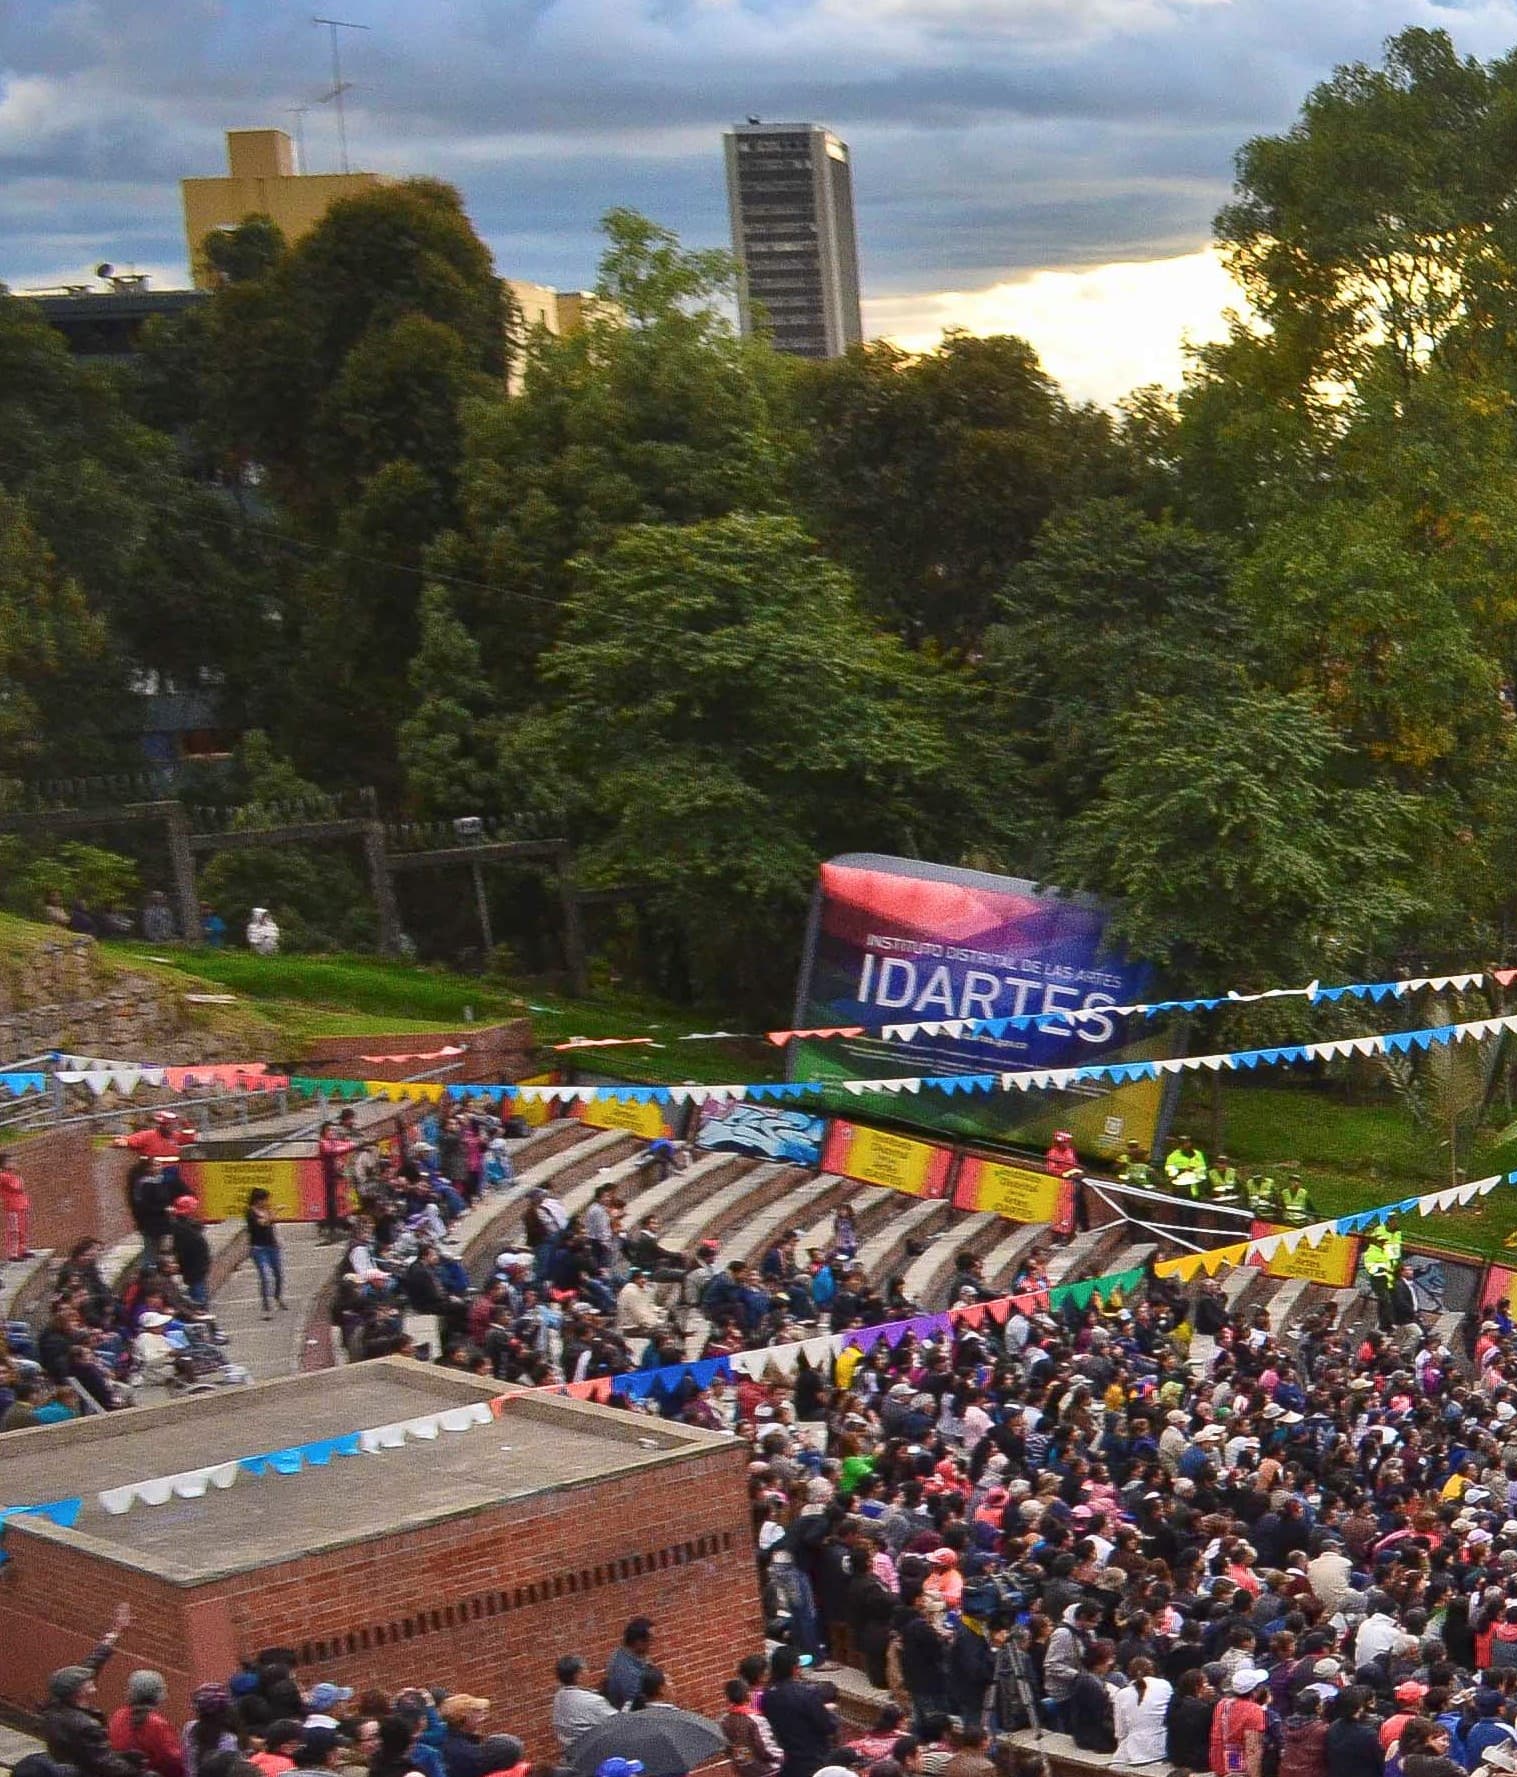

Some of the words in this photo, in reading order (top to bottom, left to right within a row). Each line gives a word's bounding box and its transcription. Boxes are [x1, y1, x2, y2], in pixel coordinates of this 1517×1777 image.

[867, 933, 945, 957] INSTITUTO
[947, 946, 1017, 970] DISTRITAL
[1021, 958, 1042, 973] DE
[1044, 960, 1074, 979] LAS
[1075, 968, 1122, 988] ARTES
[857, 953, 1117, 1042] IDARTES
